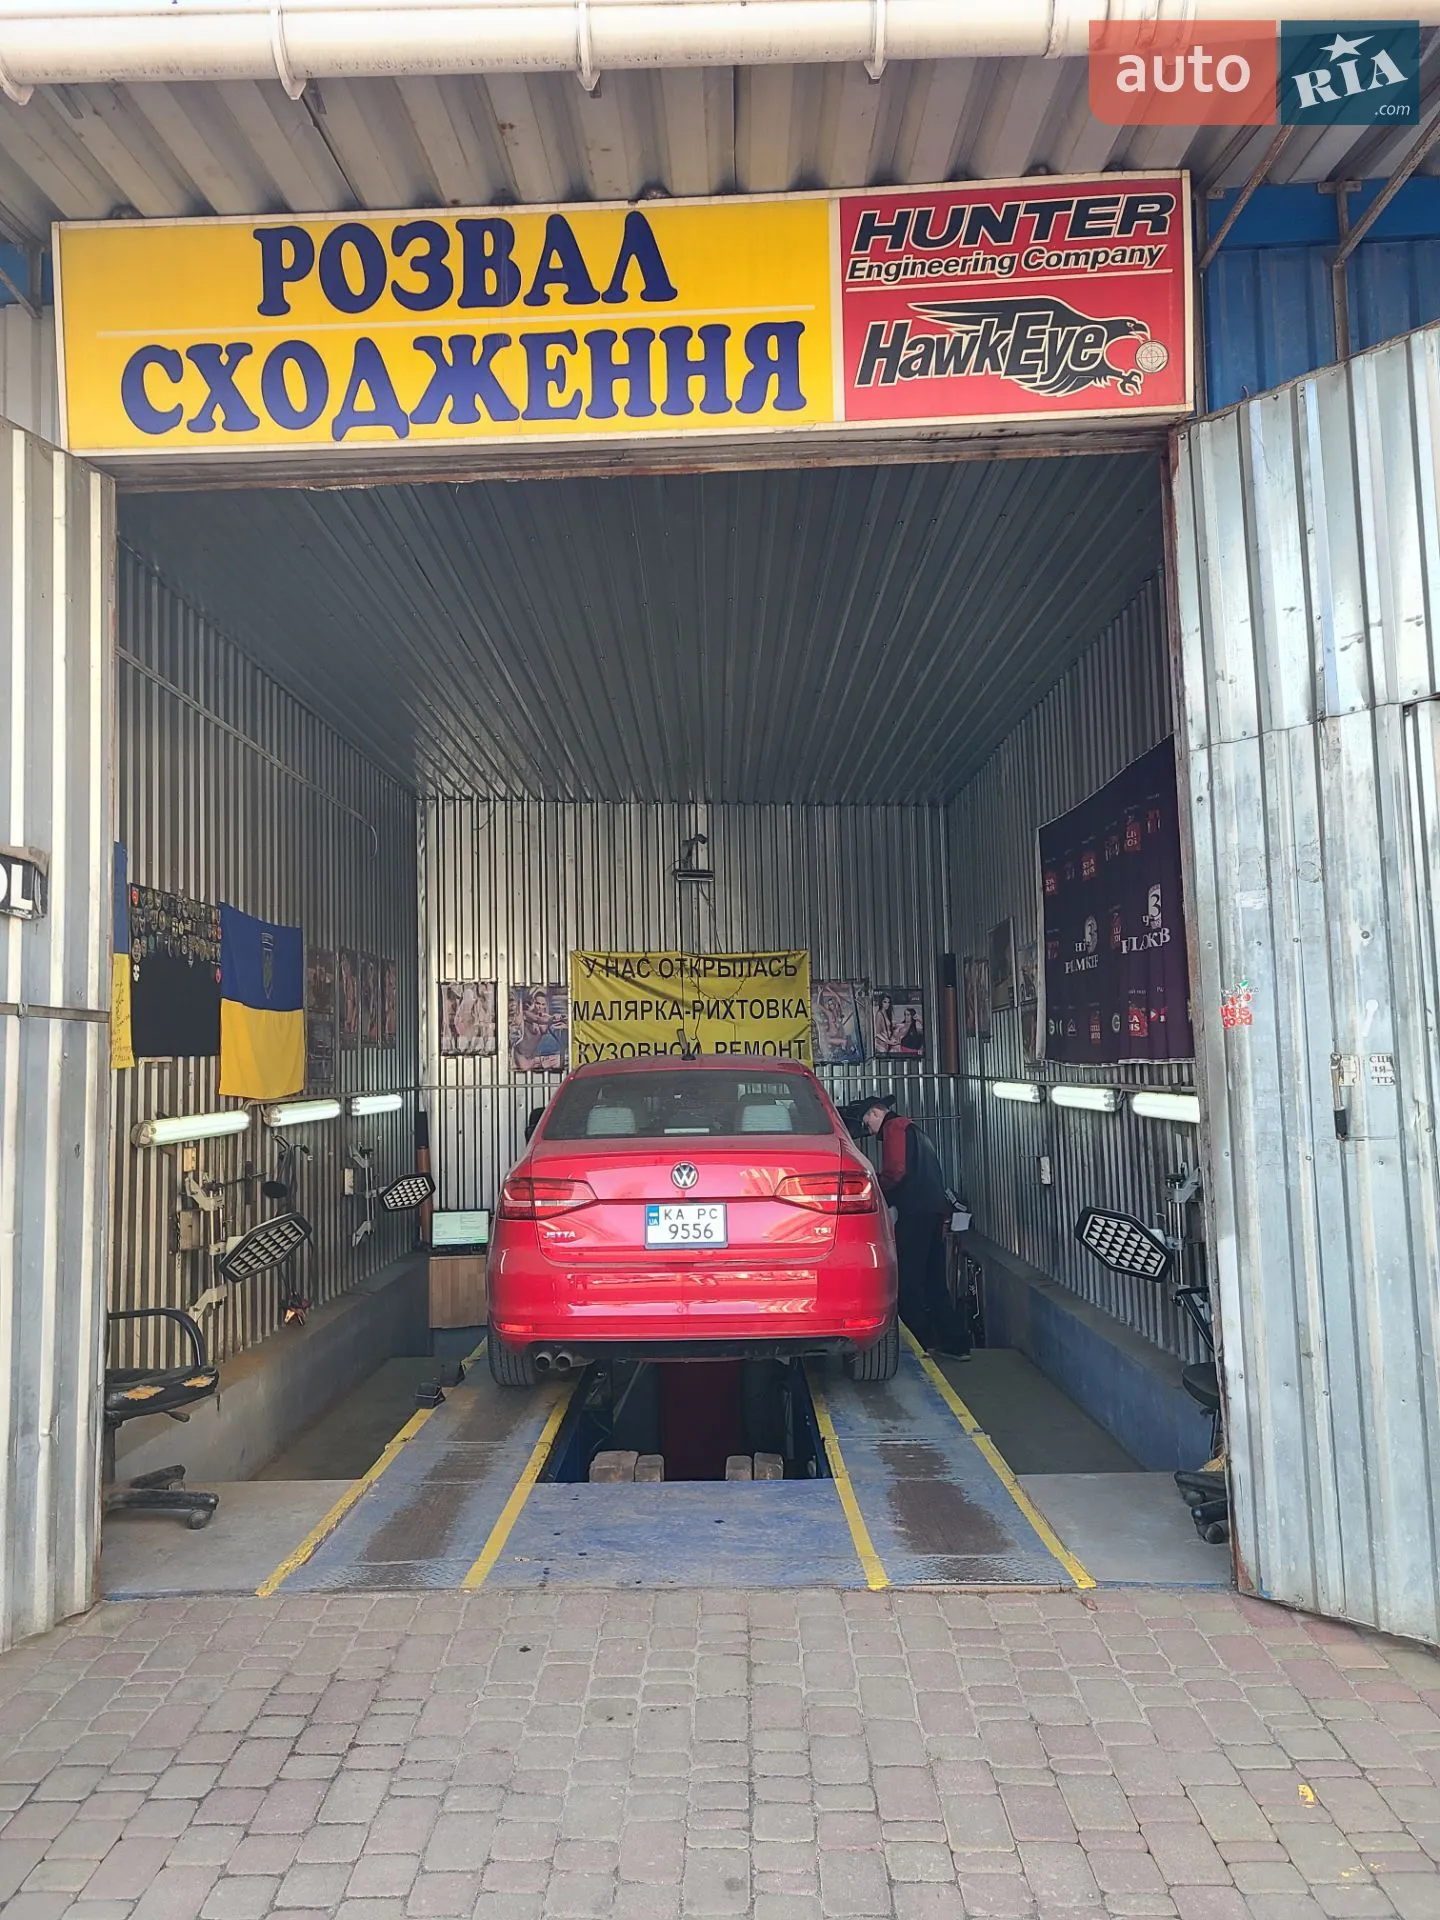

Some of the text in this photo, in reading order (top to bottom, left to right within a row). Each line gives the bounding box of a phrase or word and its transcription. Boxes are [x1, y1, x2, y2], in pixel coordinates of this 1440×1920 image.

[851, 192, 1176, 255] HUNTER
[253, 211, 678, 316] РОЗВАЛ
[845, 244, 1168, 285] Engineering Company
[854, 311, 1108, 388] HawkEye
[121, 320, 807, 442] СХОДЖЕННЯ
[586, 957, 798, 979] У НАС ОТКРЫЛАСЬ
[573, 998, 809, 1022] МАЛЯРКА-РИХТОВКА
[664, 1208, 718, 1221] KA PC
[543, 1231, 576, 1239] JETTA
[668, 1223, 714, 1240] 9556
